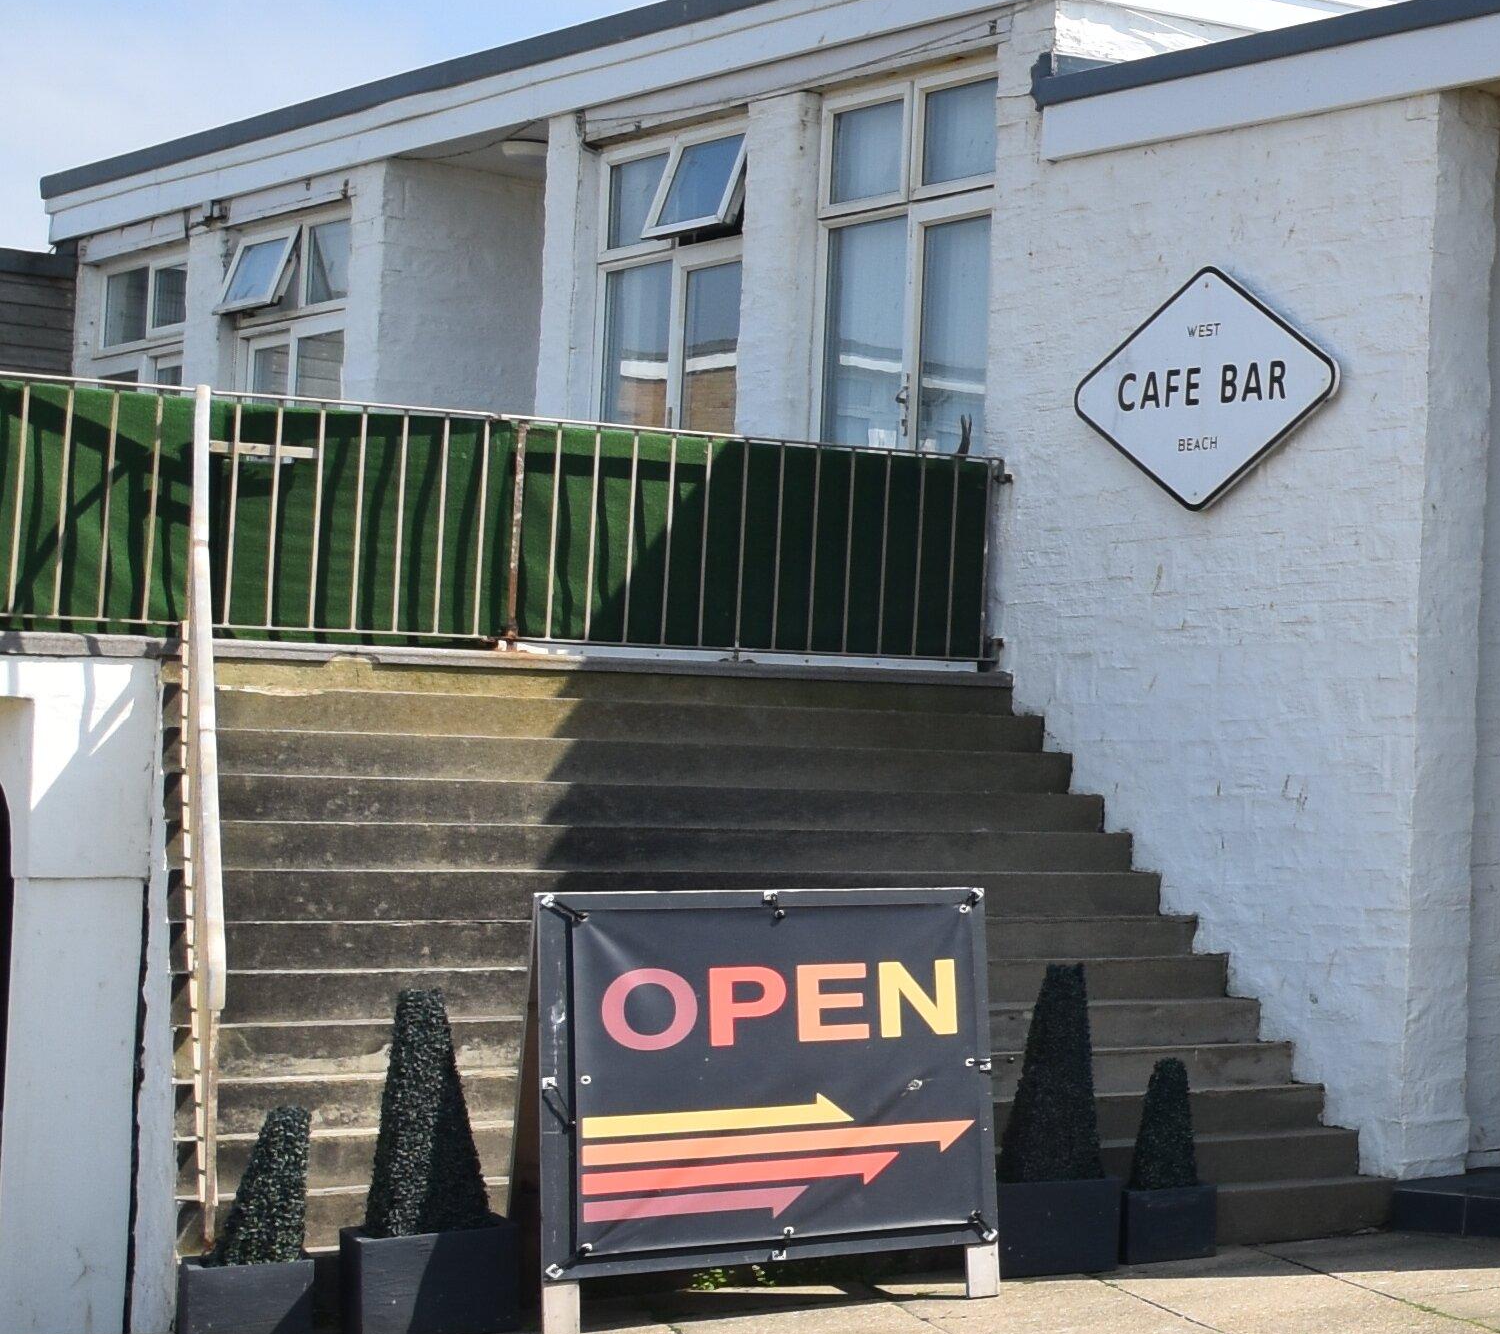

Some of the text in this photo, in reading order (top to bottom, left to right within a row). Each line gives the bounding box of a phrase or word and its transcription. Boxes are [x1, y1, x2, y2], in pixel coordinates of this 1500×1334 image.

[1188, 324, 1221, 337] WEST
[1117, 360, 1287, 412] CAFE BAR
[1177, 436, 1218, 452] BEACH
[601, 958, 959, 1051] OPEN
